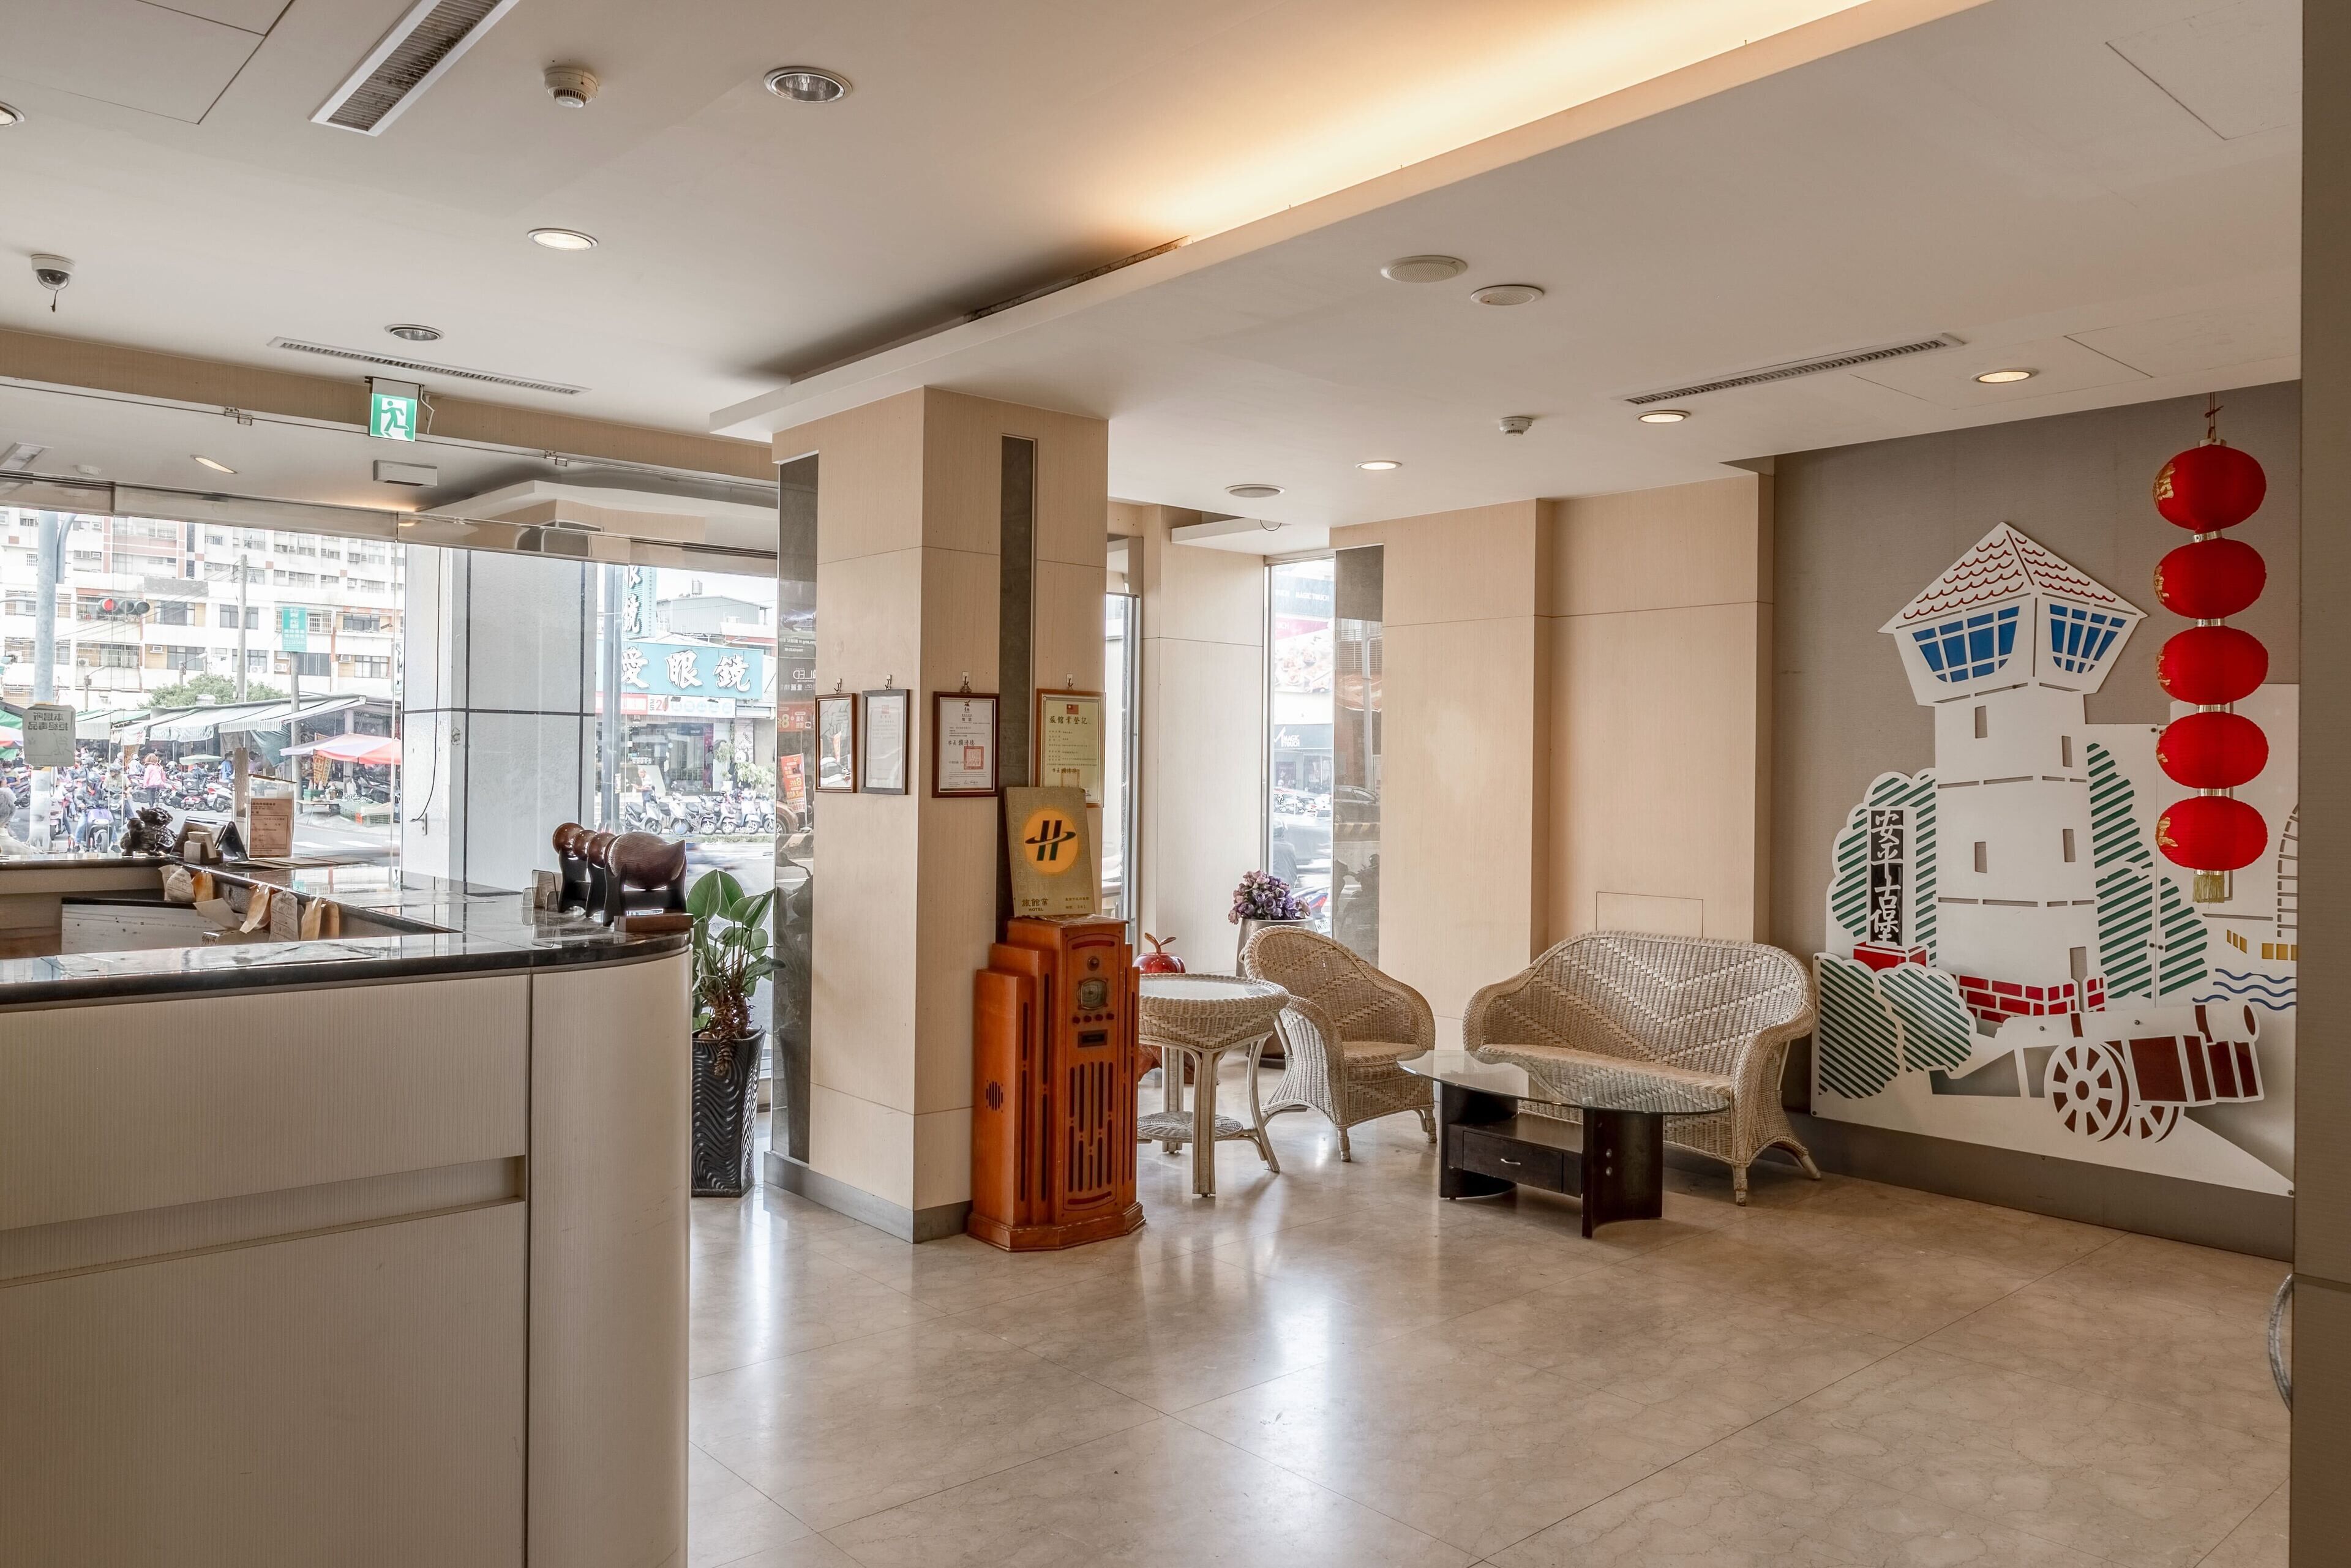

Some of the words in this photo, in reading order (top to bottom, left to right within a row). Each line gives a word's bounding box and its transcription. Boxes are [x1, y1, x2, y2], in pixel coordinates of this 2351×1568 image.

[1022, 898, 1048, 907] 旅館業
[1870, 809, 1904, 946] 安平古堡
